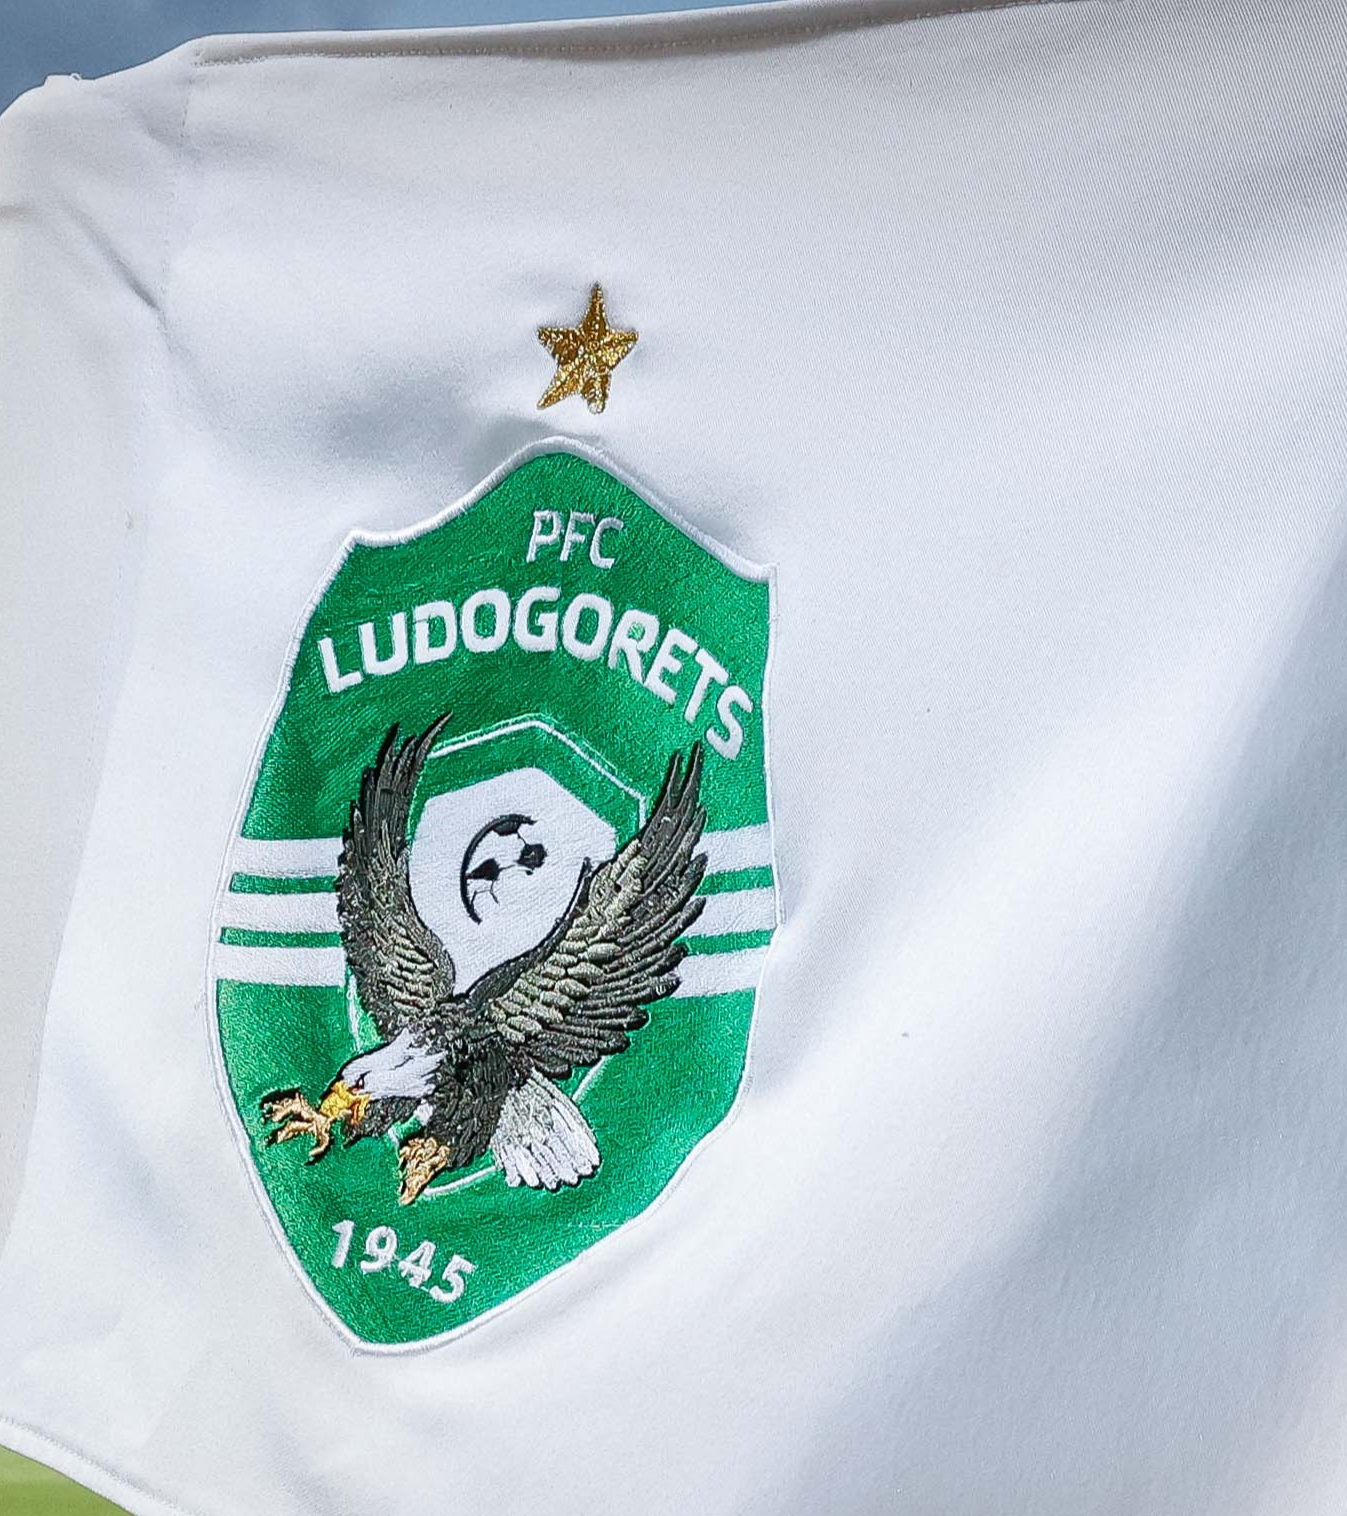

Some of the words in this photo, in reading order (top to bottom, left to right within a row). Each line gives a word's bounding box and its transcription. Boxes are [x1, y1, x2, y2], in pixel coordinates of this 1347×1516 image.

[526, 508, 625, 570] PFC
[319, 586, 754, 760] LUDOGORETS
[331, 1219, 475, 1304] 1945
